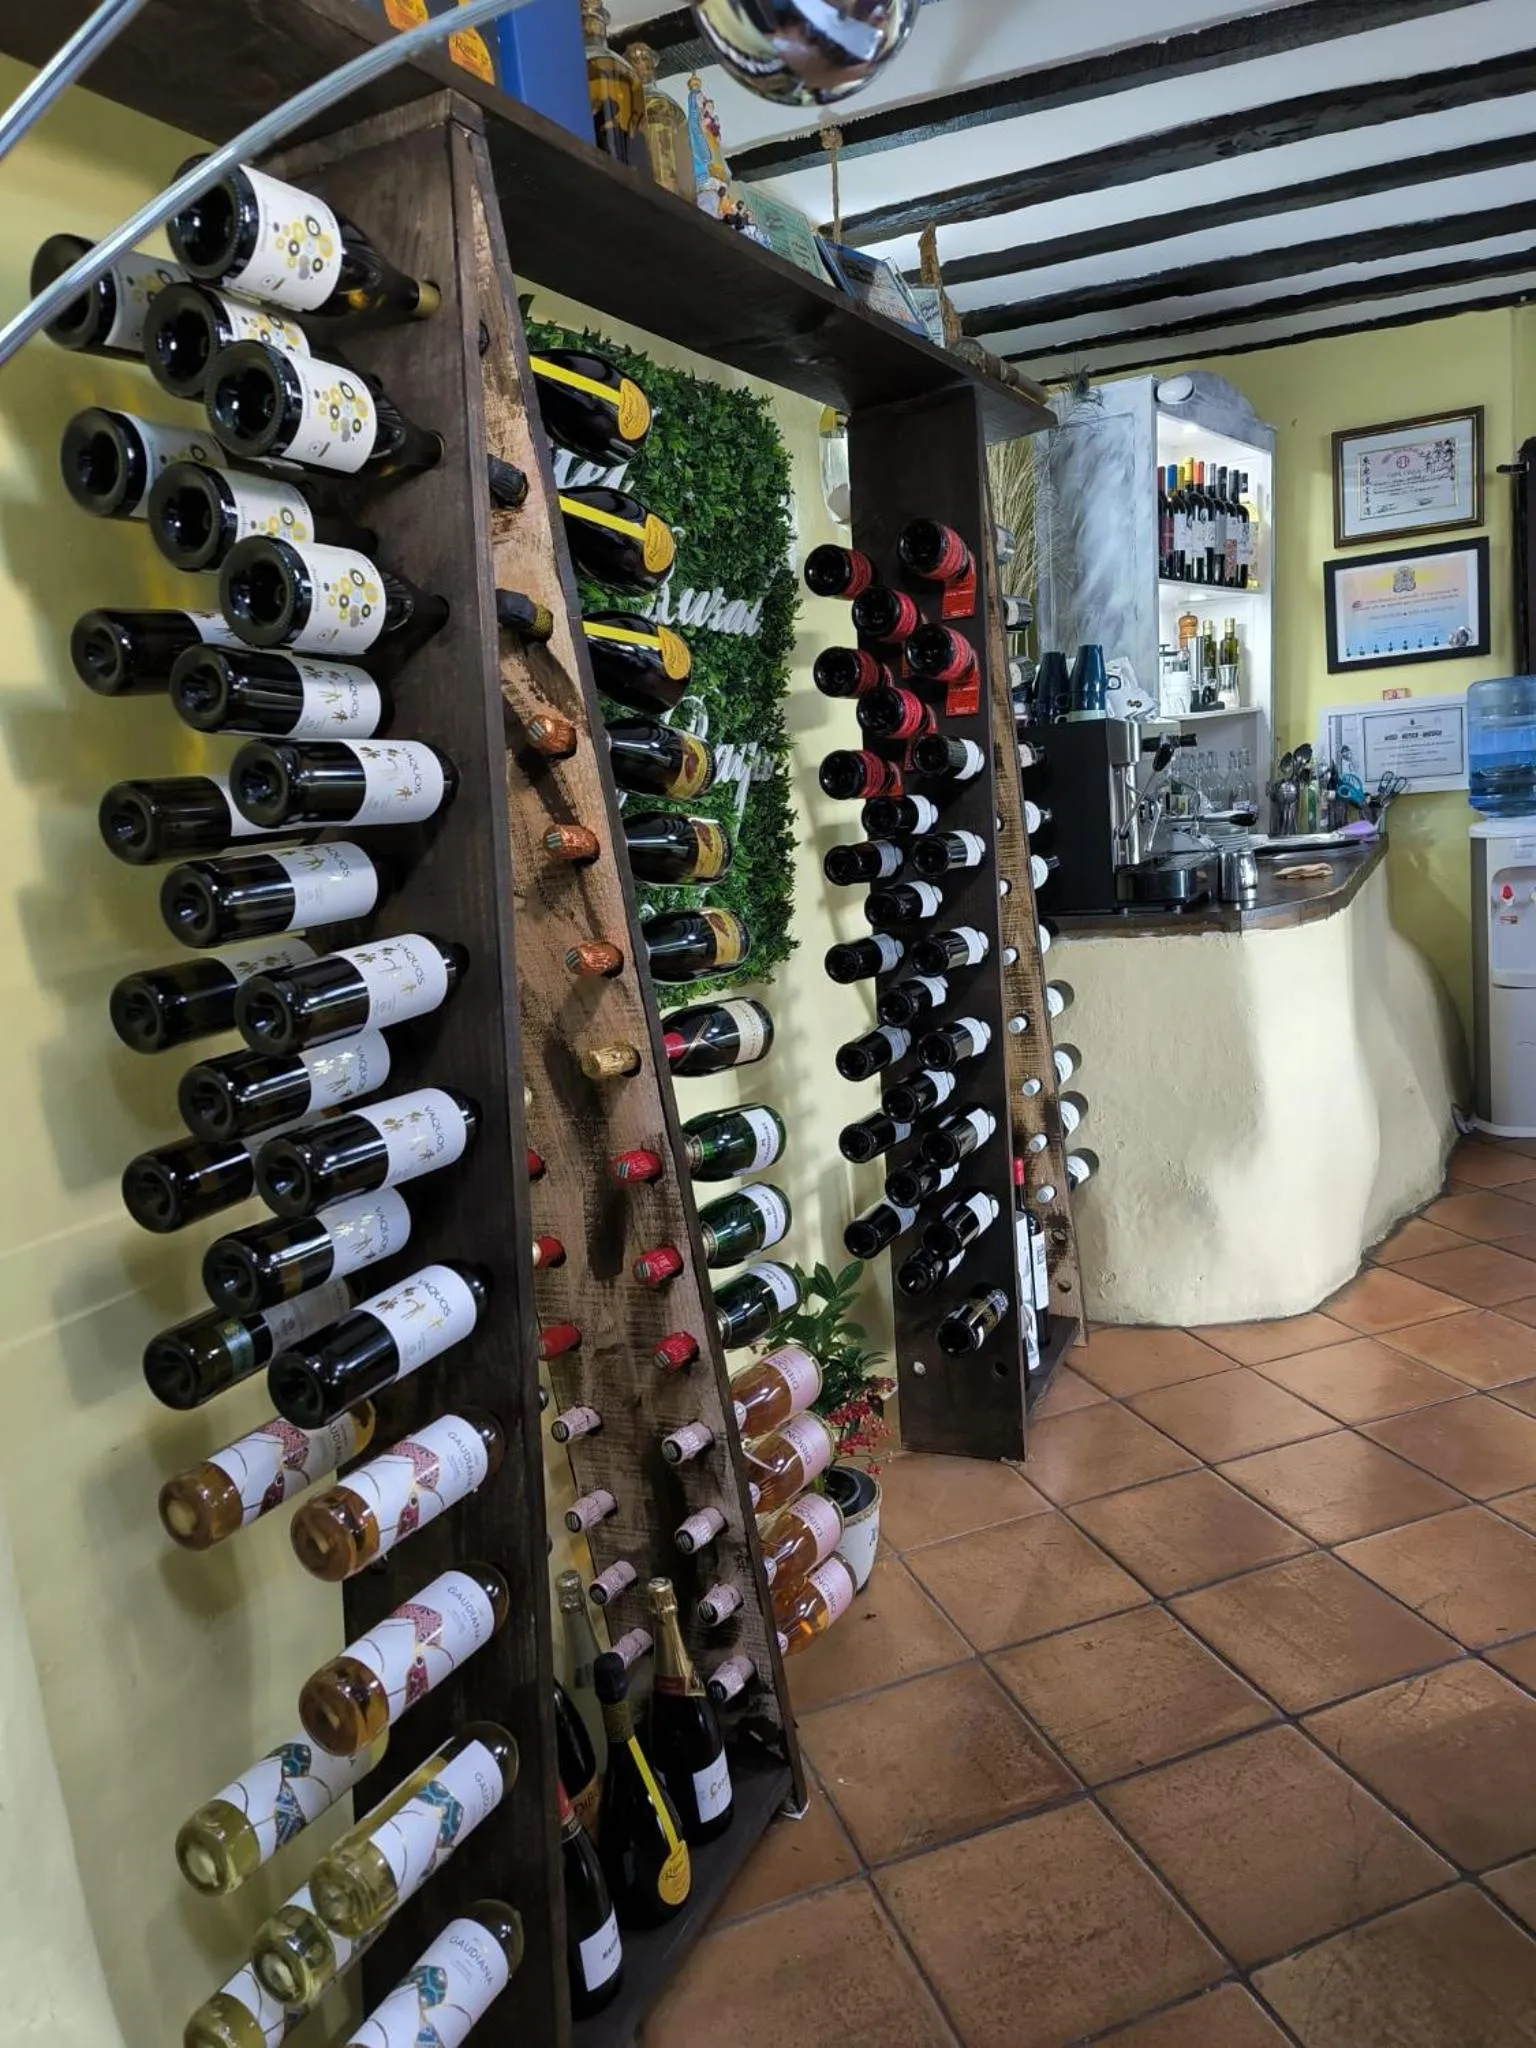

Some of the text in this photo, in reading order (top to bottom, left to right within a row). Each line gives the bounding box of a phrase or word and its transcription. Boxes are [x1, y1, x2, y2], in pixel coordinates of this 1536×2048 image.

[402, 745, 422, 794] VAQUOS
[397, 942, 425, 985] VAQUOS
[423, 1104, 446, 1154] VAQUOS
[417, 1277, 453, 1318] VAQUOS
[448, 1933, 494, 1987] GAUDIANA
